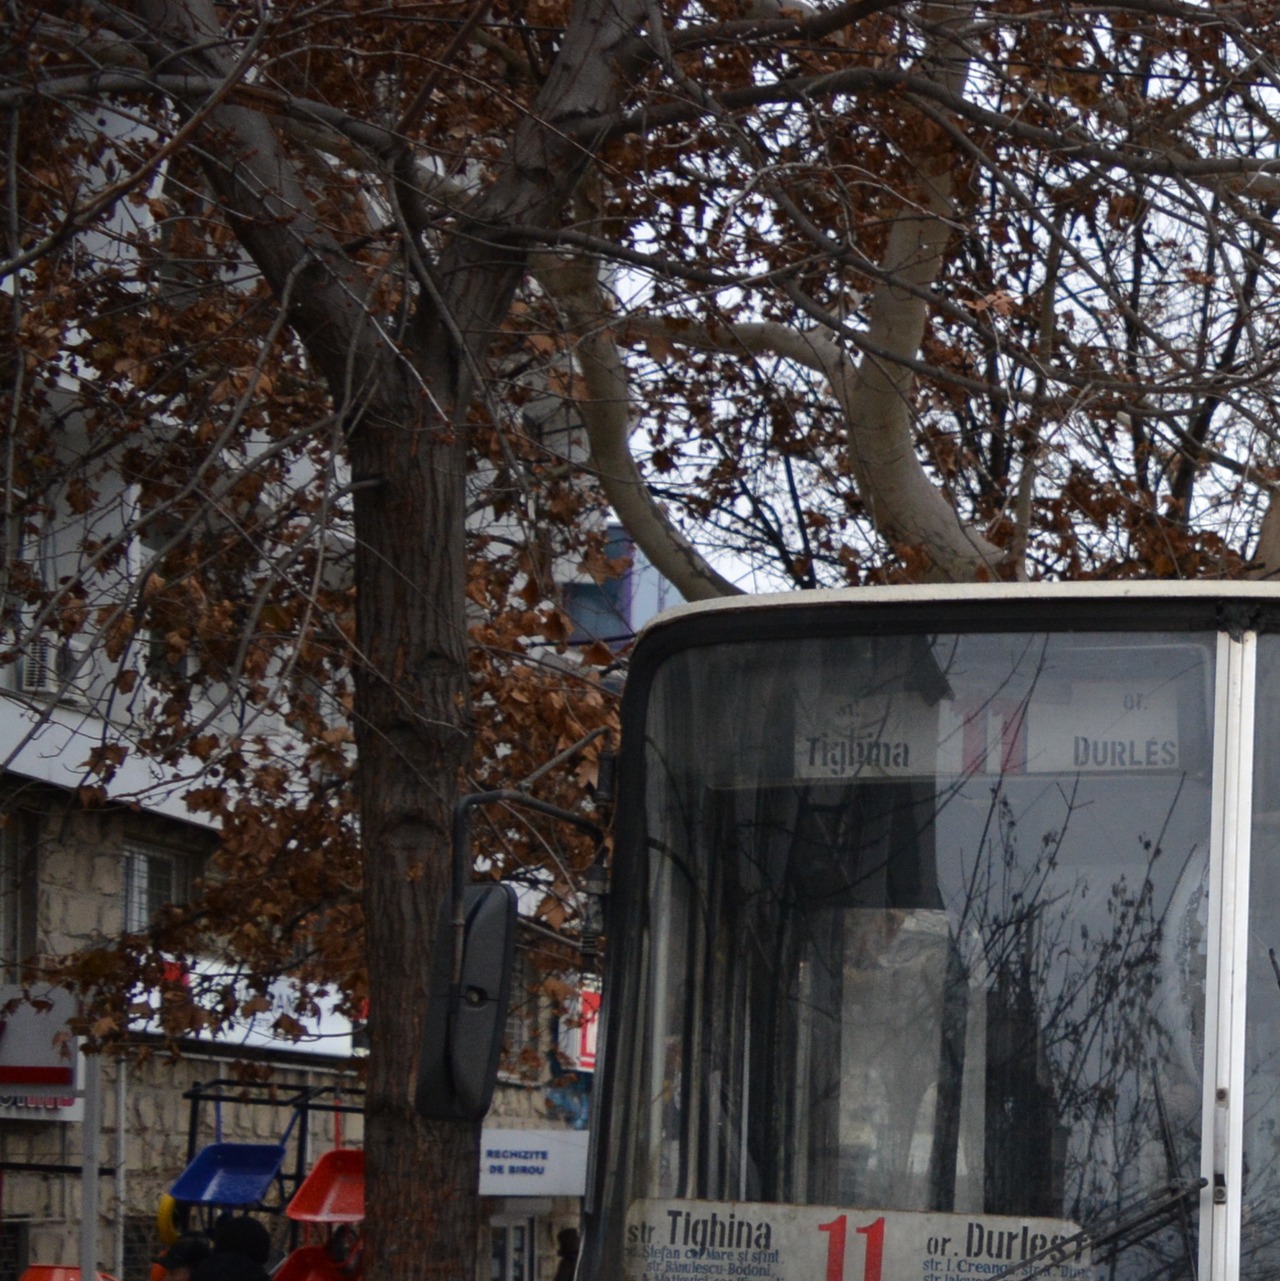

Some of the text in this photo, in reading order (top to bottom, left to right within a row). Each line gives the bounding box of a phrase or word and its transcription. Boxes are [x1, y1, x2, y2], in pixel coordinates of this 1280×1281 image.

[805, 728, 910, 776] Tighina
[486, 1149, 549, 1160] RECHIZITE
[489, 1164, 545, 1176] DE BIROU
[667, 1209, 773, 1258] Tighina
[926, 1236, 959, 1258] or.
